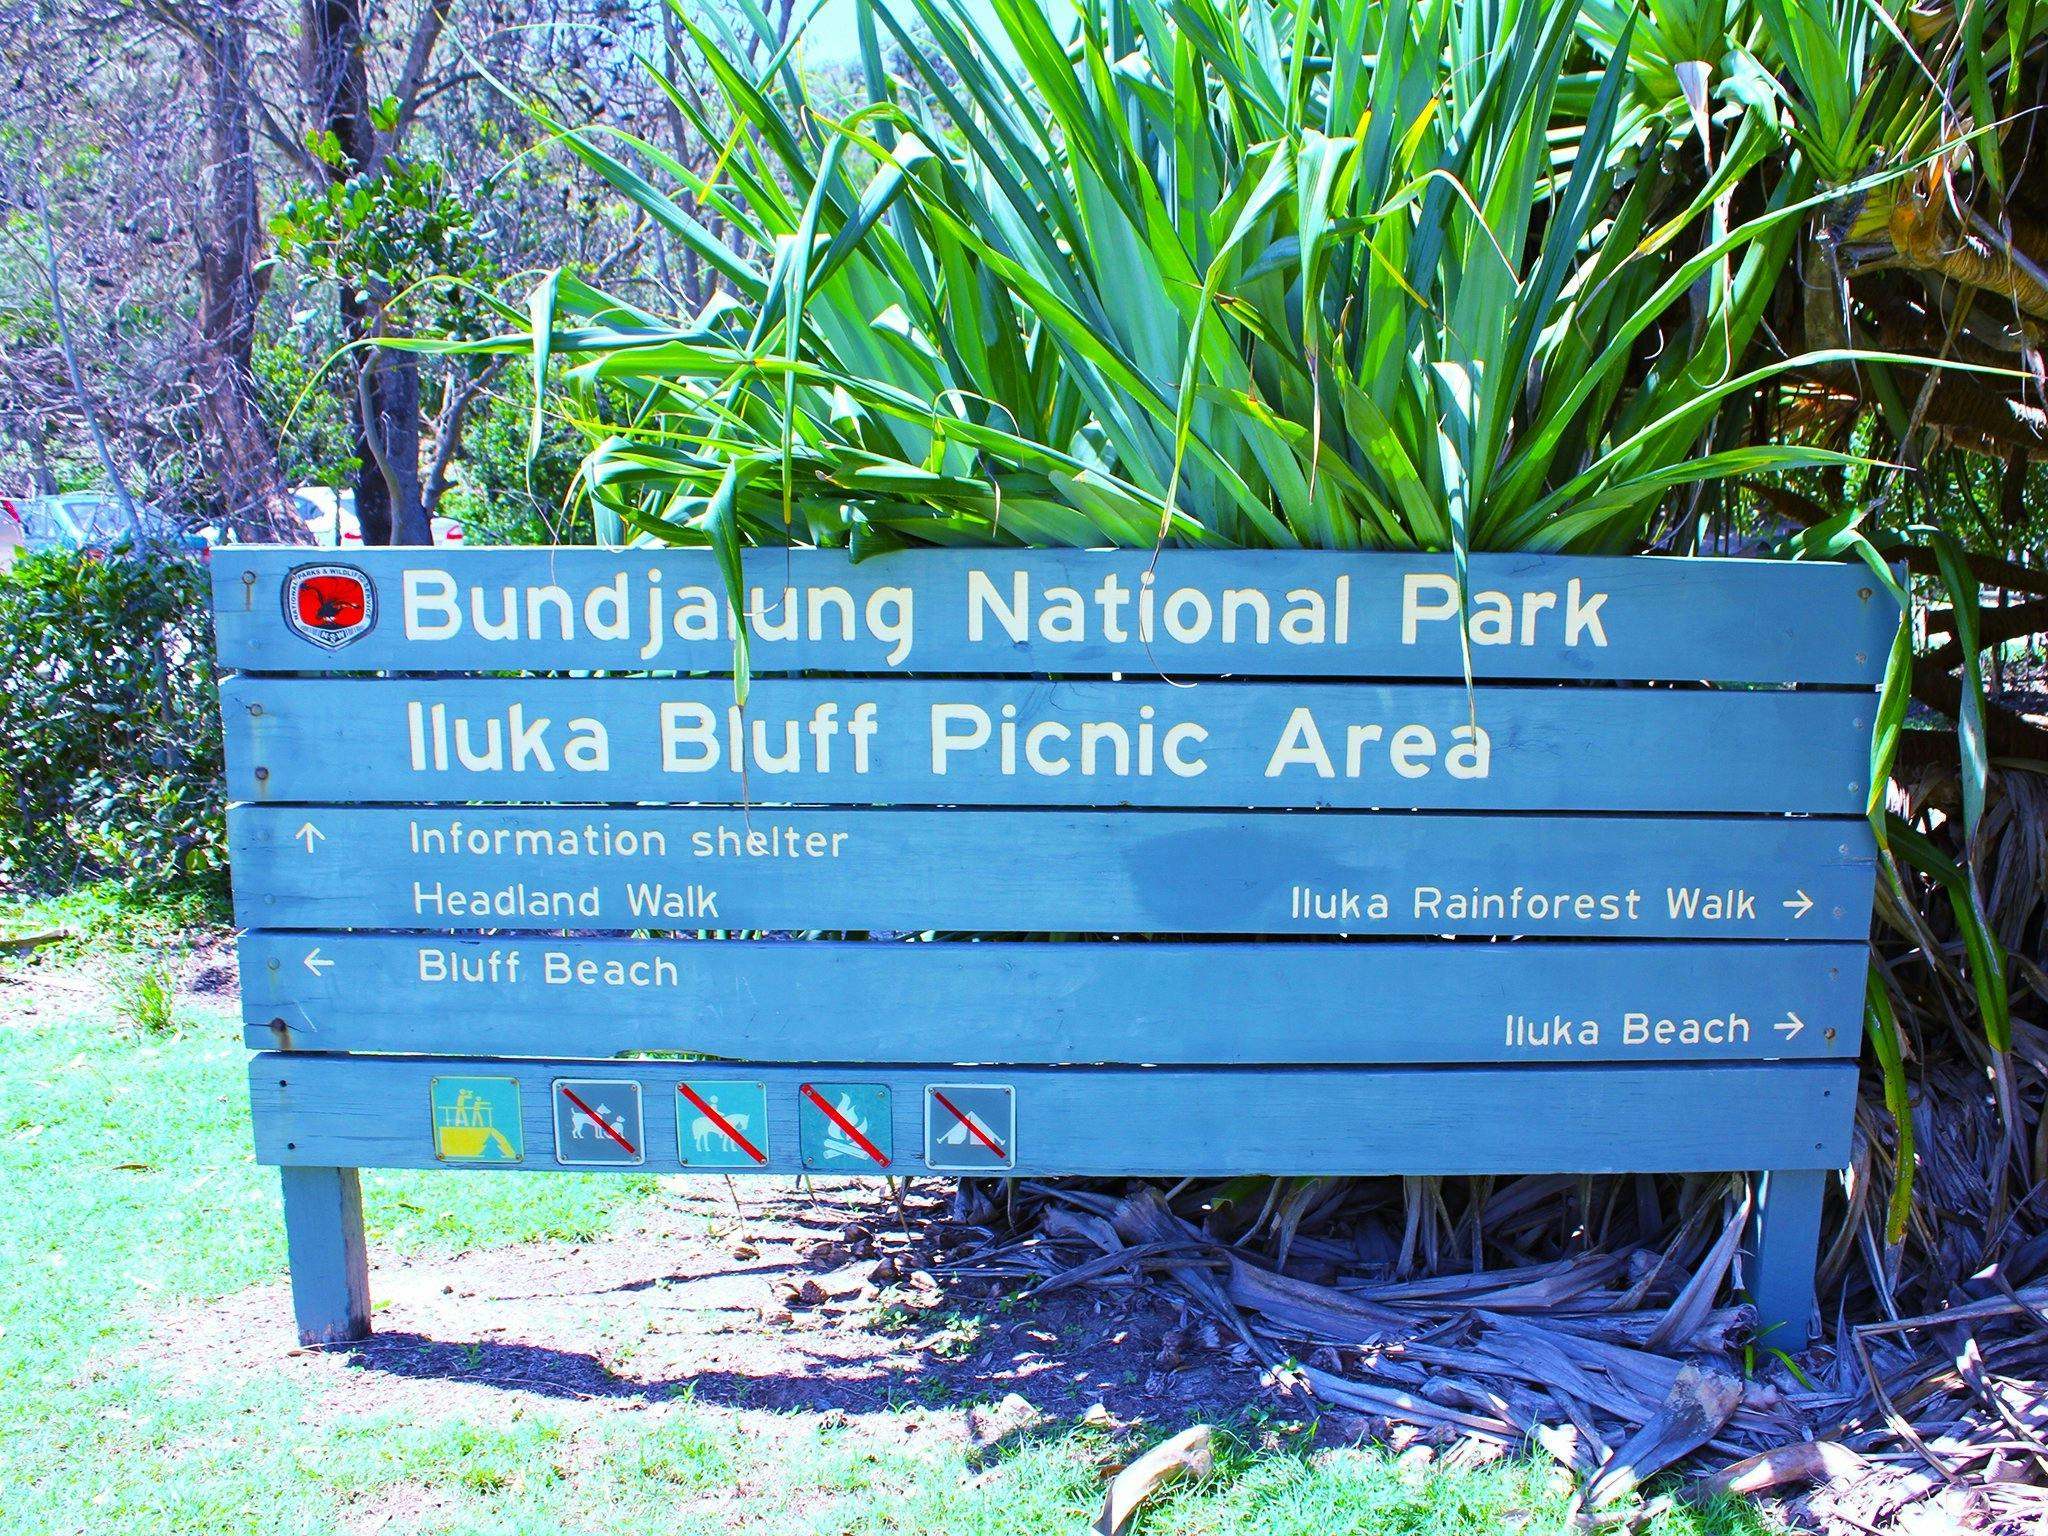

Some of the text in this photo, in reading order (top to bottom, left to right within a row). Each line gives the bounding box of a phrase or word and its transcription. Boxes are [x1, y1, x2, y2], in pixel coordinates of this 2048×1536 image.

[297, 568, 321, 580] PARKS
[968, 570, 1350, 646] National
[1401, 573, 1609, 648] Park
[408, 701, 1491, 779] Iluka Bluff Picnic Area
[410, 821, 849, 858] Information shelter
[413, 881, 719, 918] Headland Walk
[1291, 886, 1756, 920] Iluka Rainforest Walk
[418, 948, 679, 987] Bluff Beach
[1505, 1012, 1750, 1046] Iluka Beach
